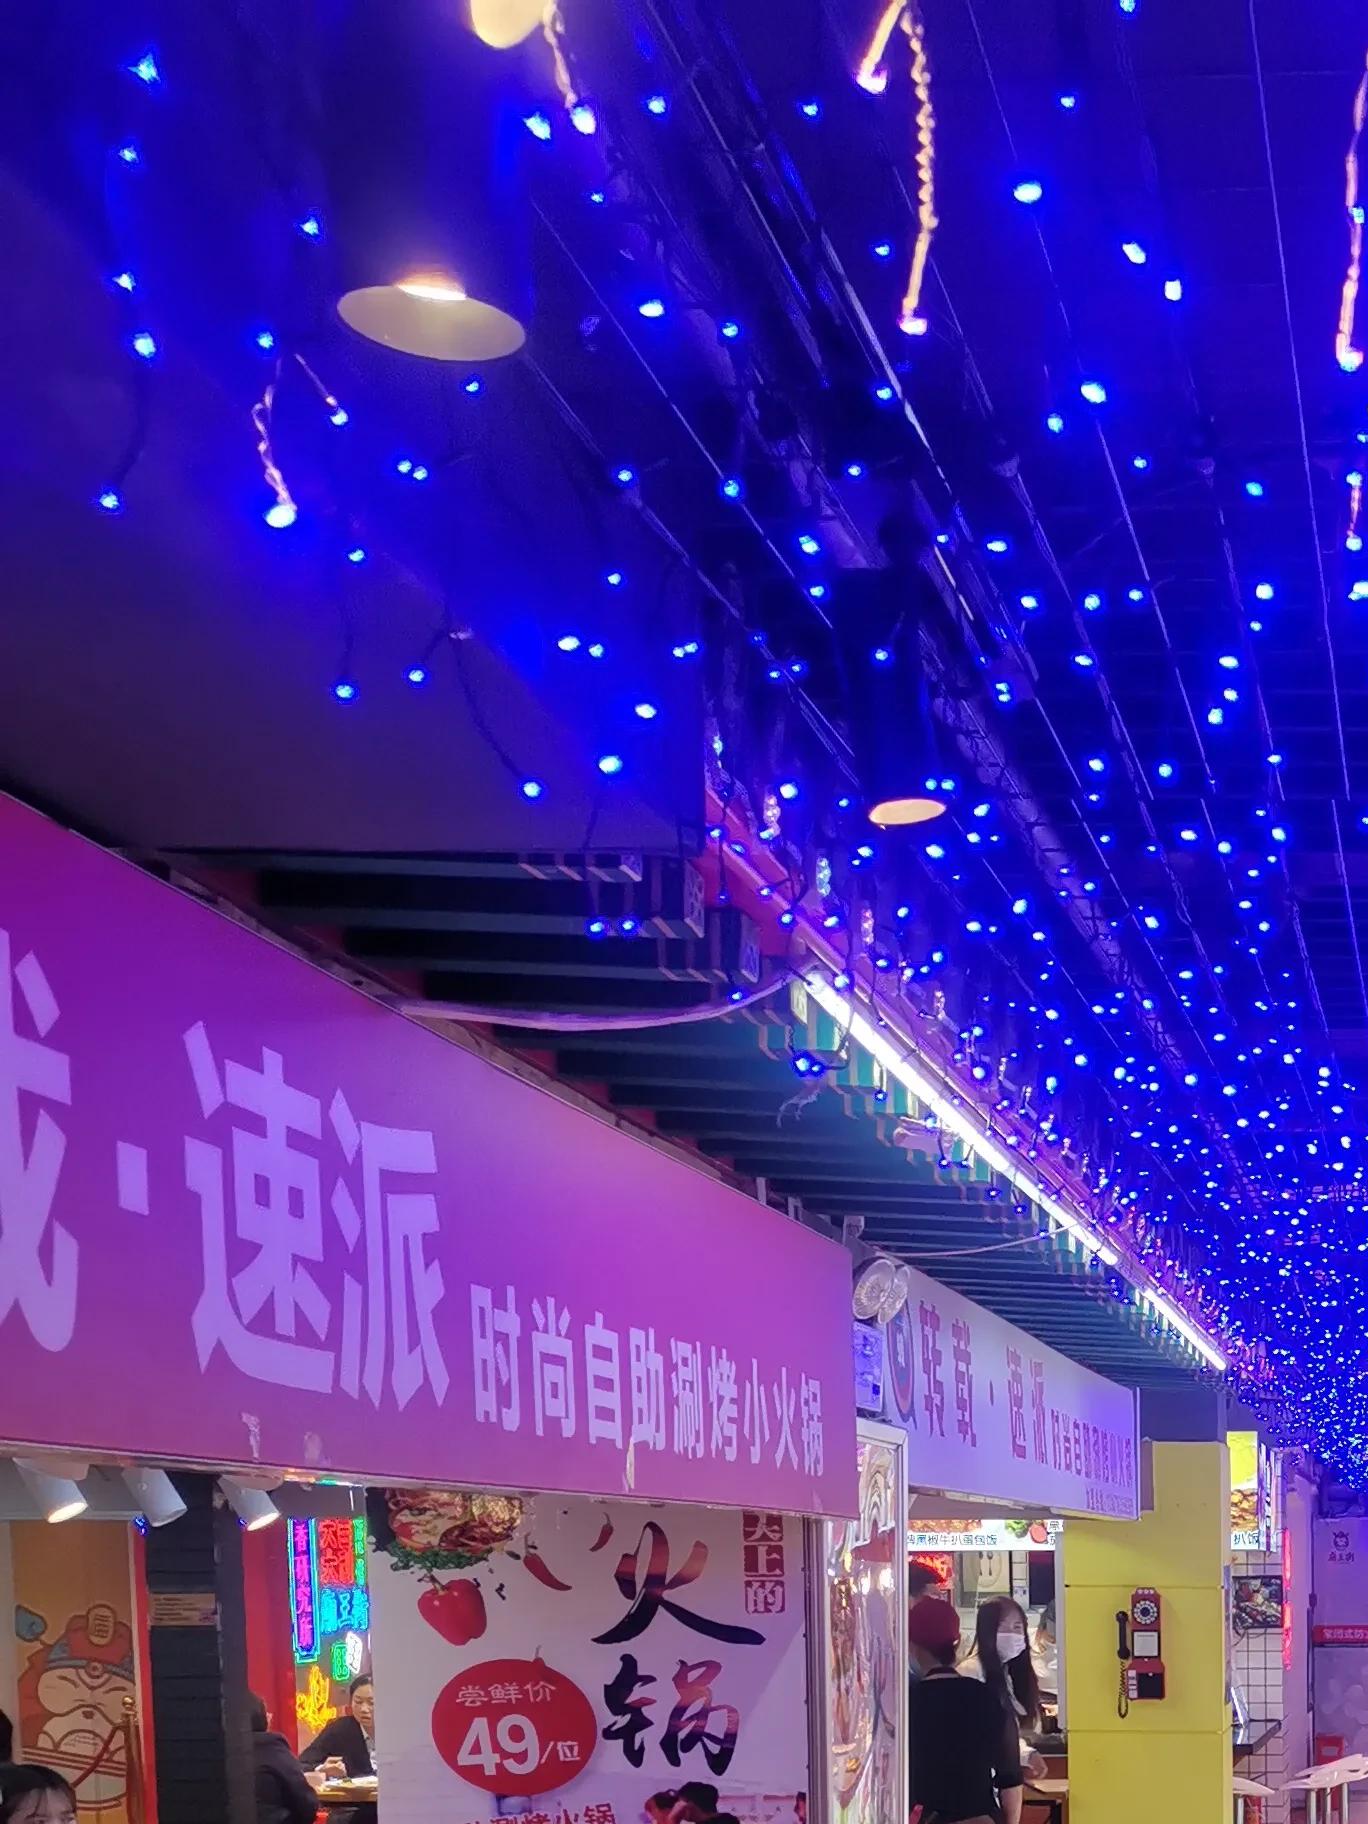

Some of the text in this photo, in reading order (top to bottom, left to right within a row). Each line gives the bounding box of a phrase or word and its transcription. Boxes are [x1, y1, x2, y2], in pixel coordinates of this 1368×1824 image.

[470, 1283, 824, 1479] 时尚自助涮烤小火锅
[455, 1680, 557, 1707] 尝鲜价
[592, 1520, 766, 1777] 火锅
